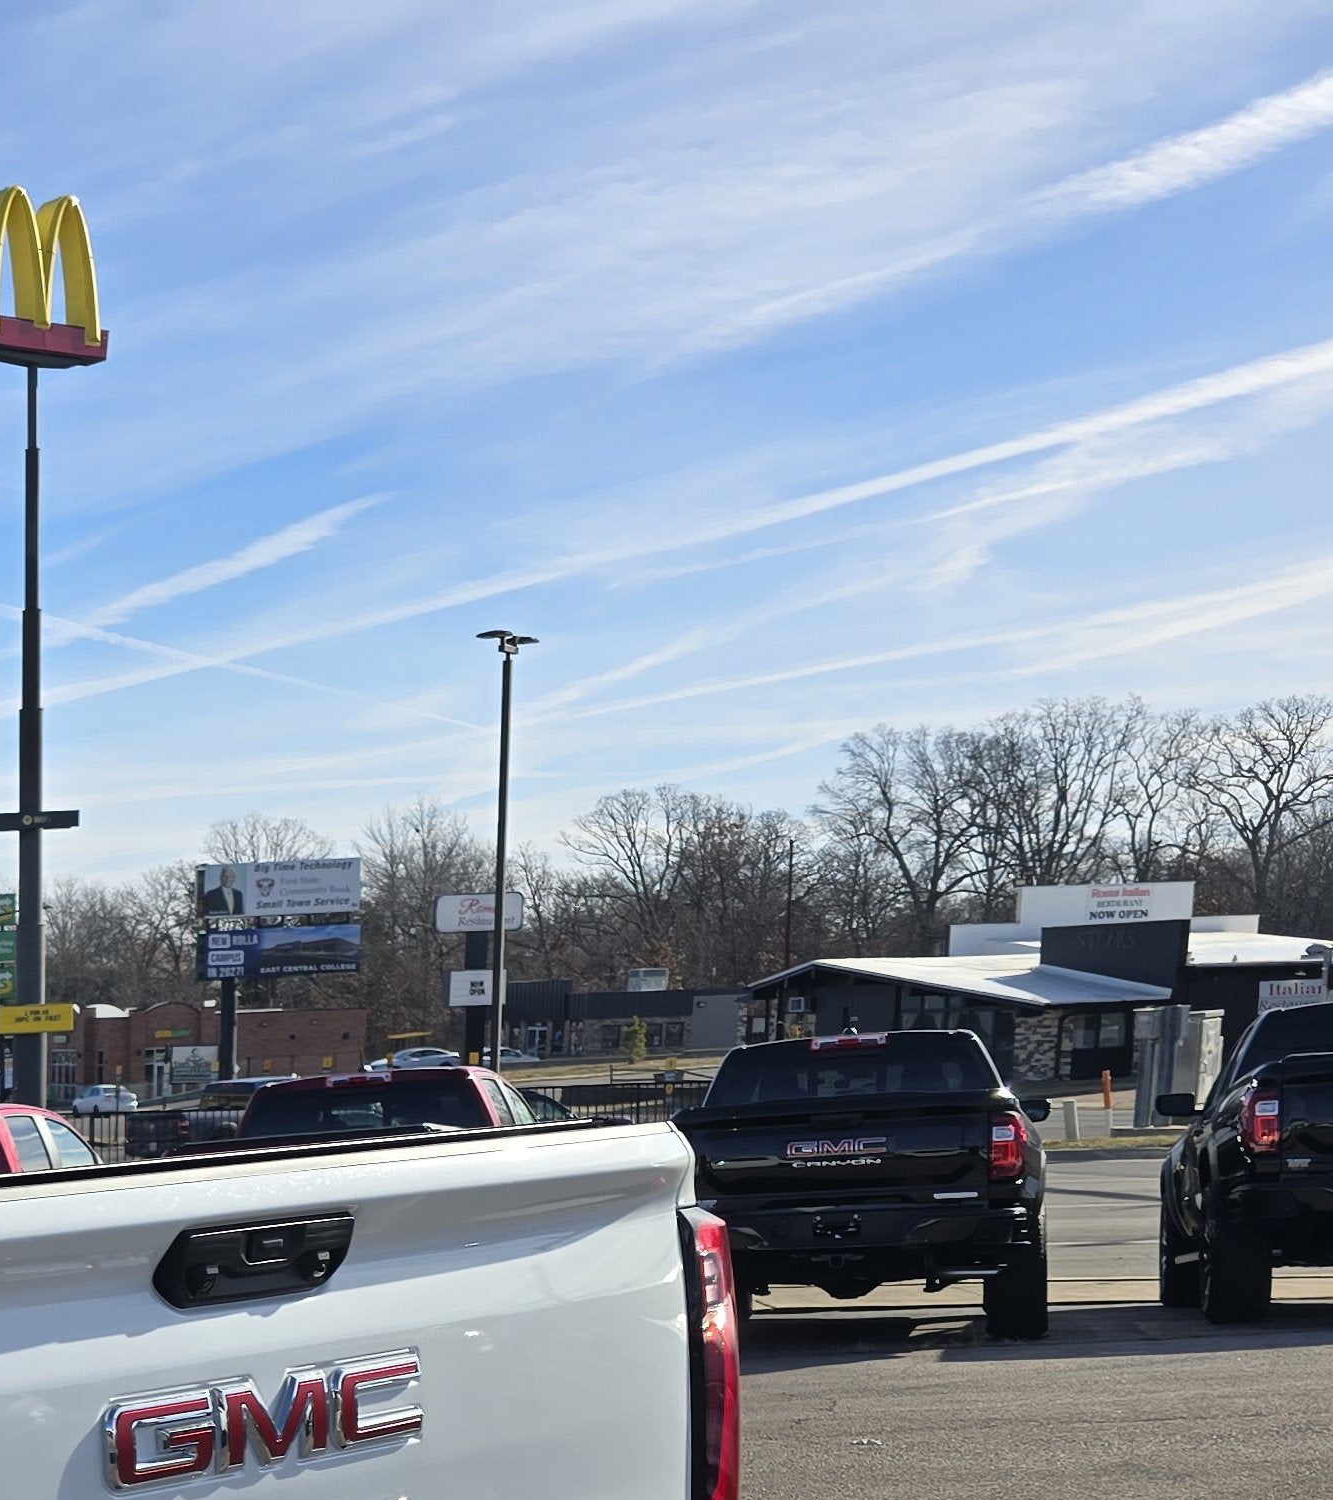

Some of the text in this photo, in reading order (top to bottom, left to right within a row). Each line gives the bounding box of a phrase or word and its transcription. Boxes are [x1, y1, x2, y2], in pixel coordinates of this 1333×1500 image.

[255, 860, 353, 873] Big Time Technology
[256, 900, 283, 910] Small
[286, 899, 311, 908] Town
[313, 897, 351, 906] Service
[1089, 910, 1149, 920] NOW OPEN
[211, 934, 259, 946] NEW ROLLA
[211, 952, 242, 963] CAMPUS
[207, 968, 218, 978] IN
[283, 965, 319, 973] CENTRAL
[786, 1136, 887, 1158] GMC
[792, 1158, 882, 1168] CANYON
[104, 1347, 425, 1496] GMC
